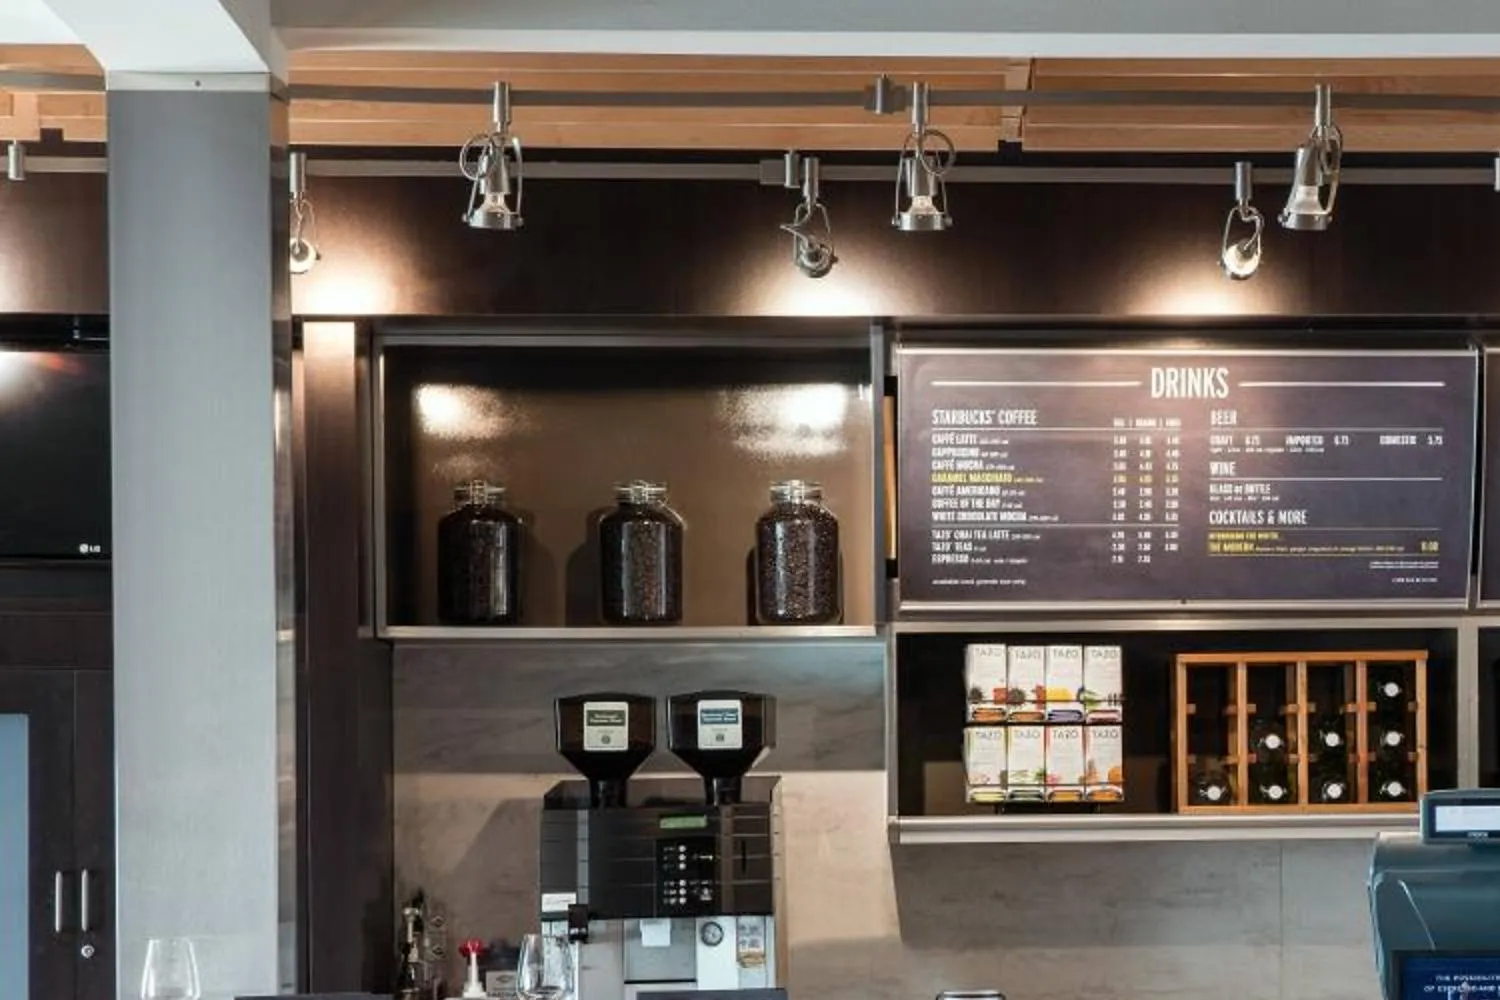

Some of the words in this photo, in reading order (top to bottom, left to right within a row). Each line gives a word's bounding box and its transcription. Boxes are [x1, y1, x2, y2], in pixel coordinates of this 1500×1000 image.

[1151, 367, 1229, 399] DRINKS
[998, 410, 1038, 425] COFFEE
[1210, 409, 1237, 425] BEER
[1209, 462, 1236, 476] WINE
[1209, 510, 1264, 525] COCKTAILS
[1279, 510, 1307, 525] MORE
